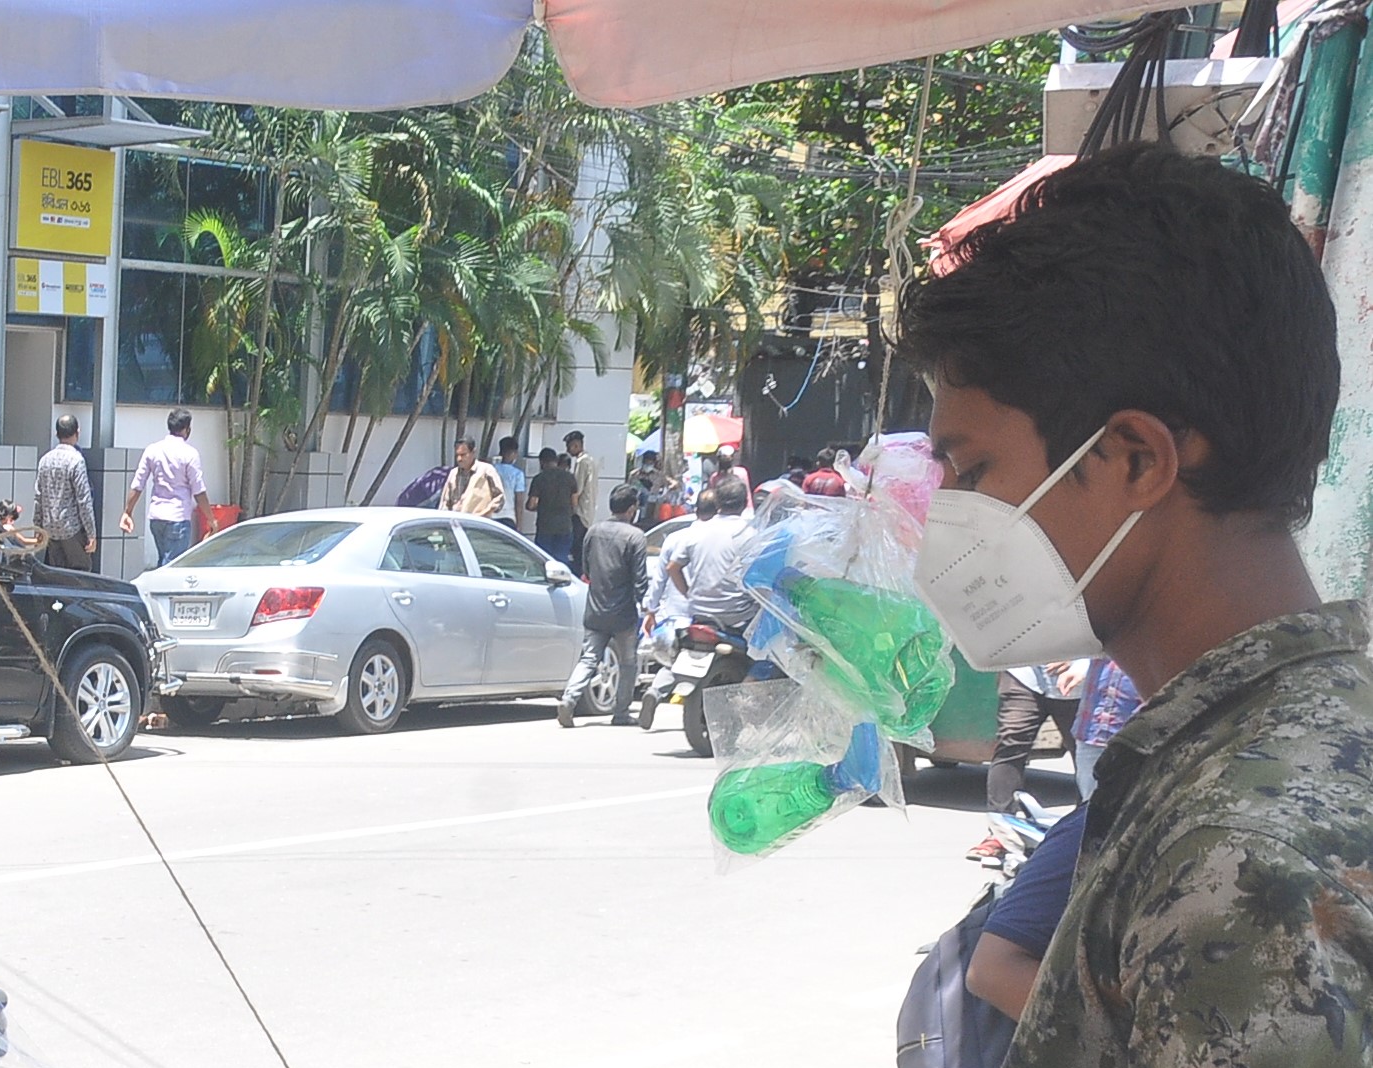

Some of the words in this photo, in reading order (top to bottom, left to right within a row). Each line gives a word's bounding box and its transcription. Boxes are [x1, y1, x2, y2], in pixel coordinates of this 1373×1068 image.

[42, 167, 65, 190] EBL
[66, 170, 92, 192] 365
[962, 575, 987, 597] KN95
